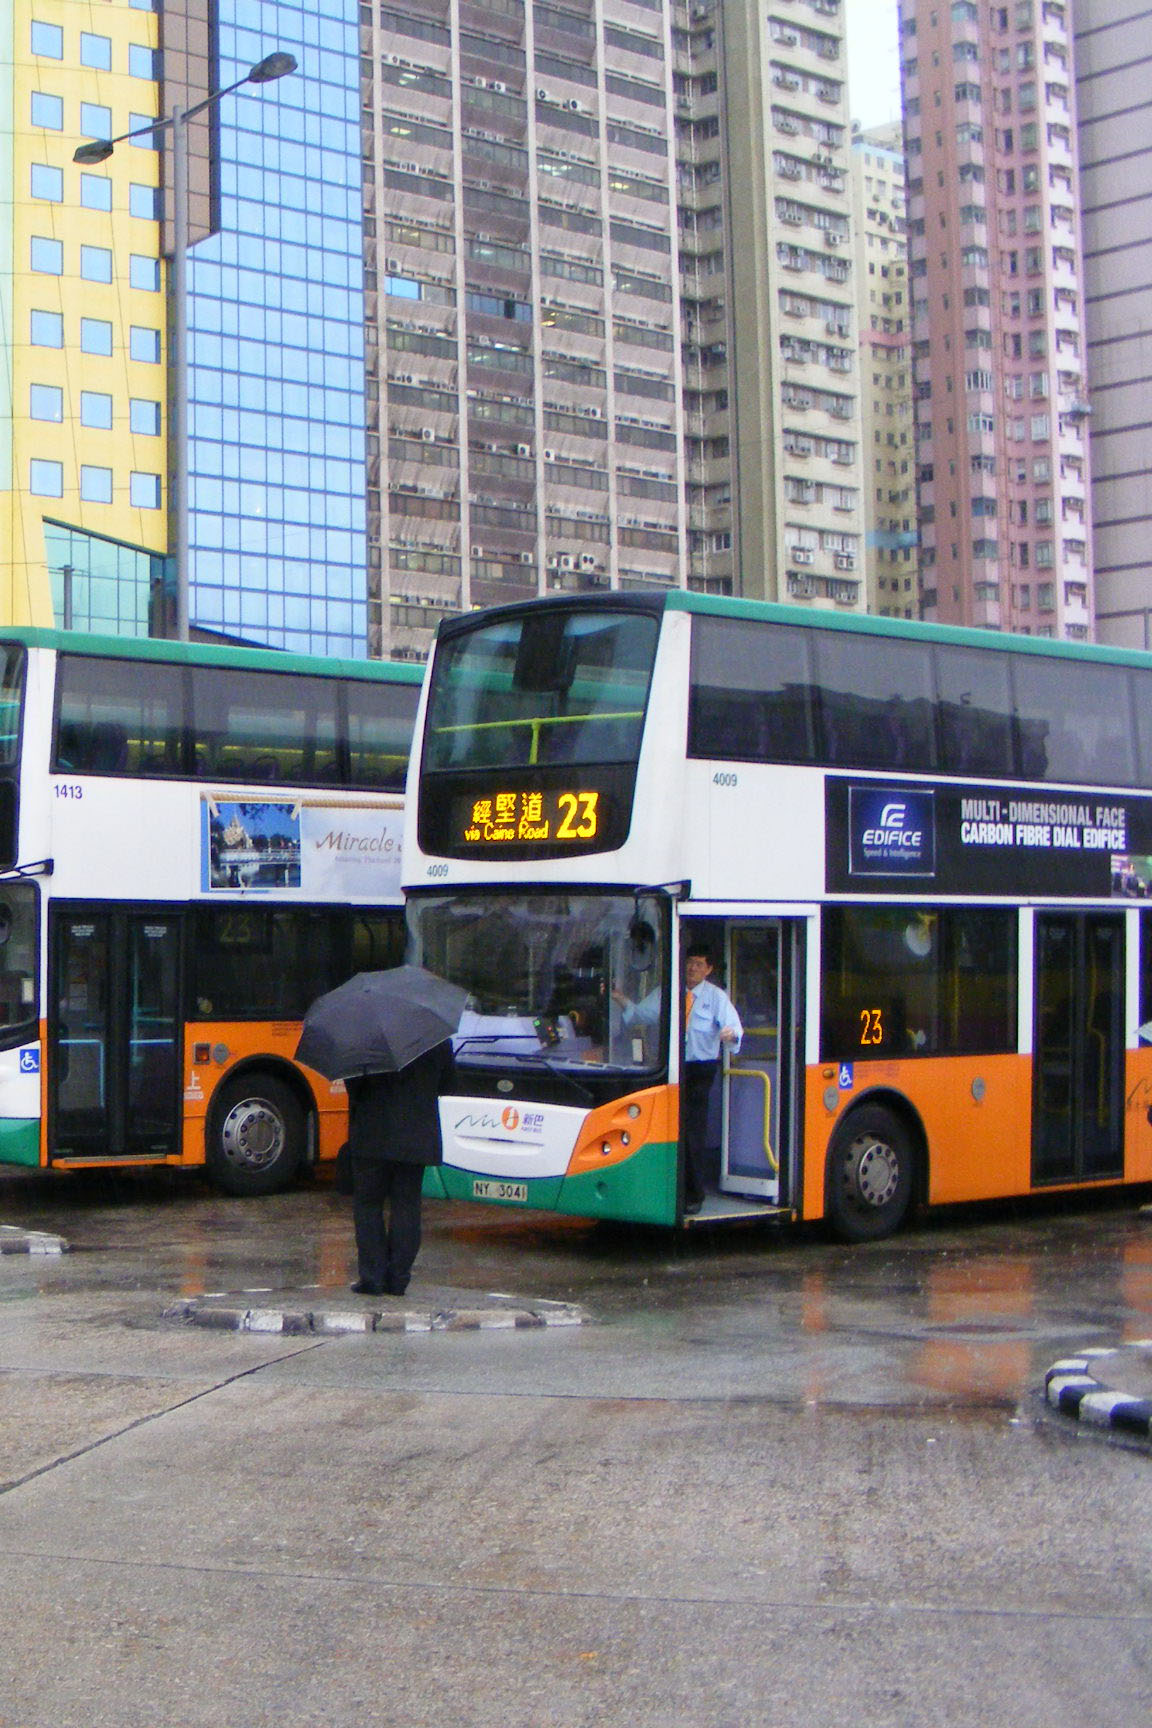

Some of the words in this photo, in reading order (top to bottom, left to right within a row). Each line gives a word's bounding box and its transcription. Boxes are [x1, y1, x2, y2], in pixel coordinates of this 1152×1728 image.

[712, 772, 738, 787] 4009
[54, 785, 83, 799] 1413
[472, 791, 543, 824] 經堅道
[556, 791, 599, 839] 23
[1096, 806, 1126, 827] FACE
[315, 827, 394, 853] Miracle
[464, 825, 481, 841] via
[484, 822, 515, 841] Caine
[518, 820, 549, 840] Road
[862, 829, 922, 847] EDIFICE
[961, 821, 1014, 845] CARBON
[1016, 825, 1051, 847] FIBRE
[1053, 827, 1081, 848] DIAL
[1083, 827, 1126, 850] EDIFICE
[426, 864, 449, 877] 4009
[860, 1009, 883, 1045] 23
[474, 1182, 490, 1195] NY
[499, 1184, 526, 1200] 3041
